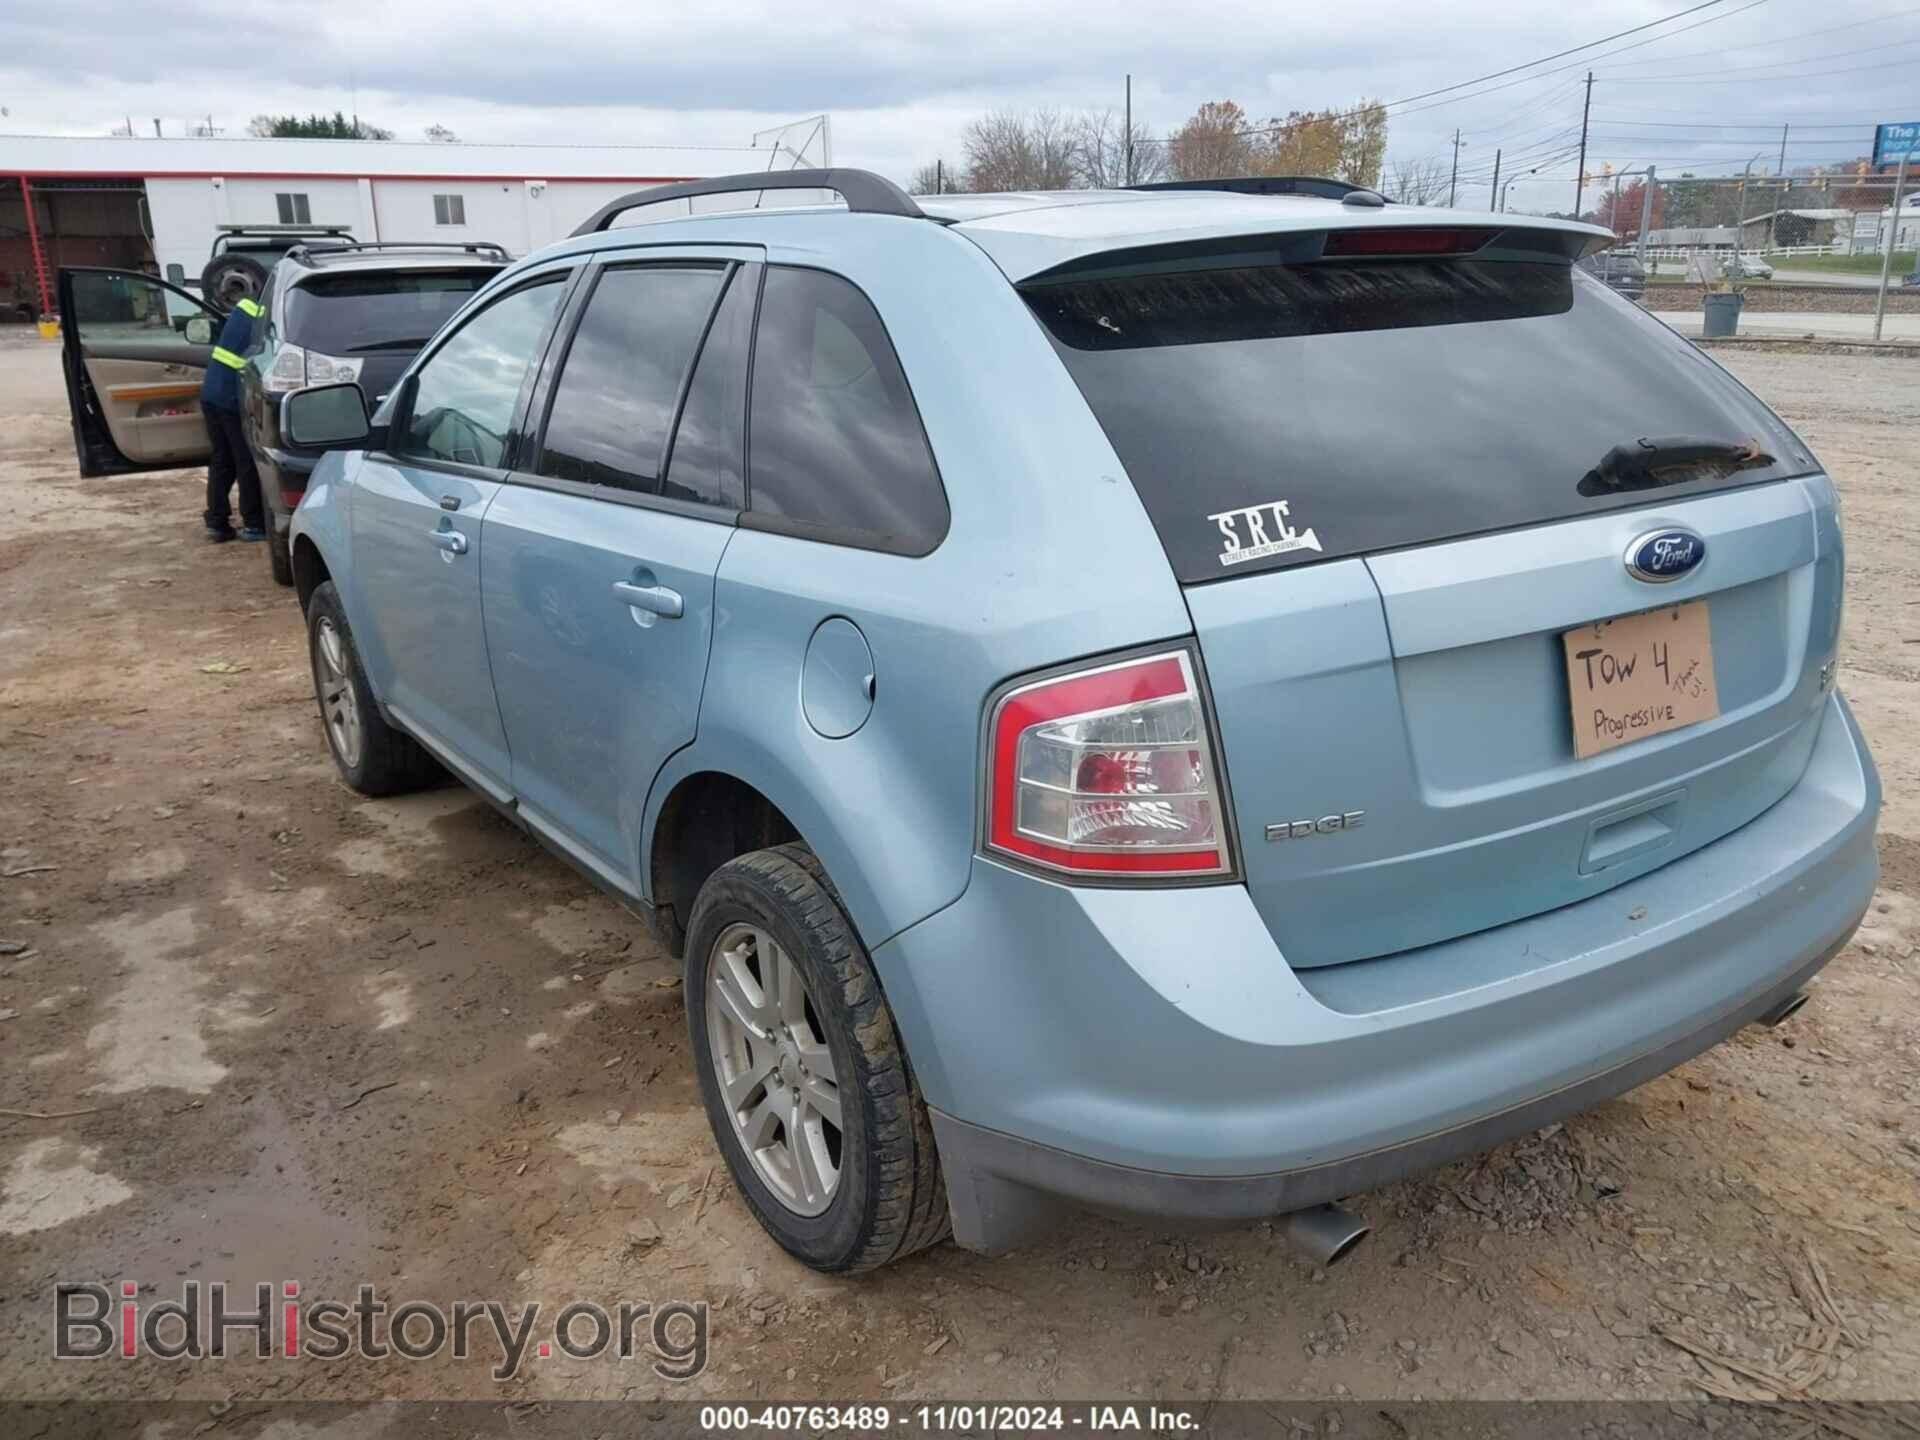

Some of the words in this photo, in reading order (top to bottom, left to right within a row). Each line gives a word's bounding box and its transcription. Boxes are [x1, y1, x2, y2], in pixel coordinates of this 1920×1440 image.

[1887, 126, 1914, 138] The
[1248, 544, 1272, 558] RACING
[1652, 538, 1693, 570] Ford
[1653, 642, 1670, 685] 4
[1593, 705, 1675, 739] Progressive
[1265, 810, 1365, 841] EDGE
